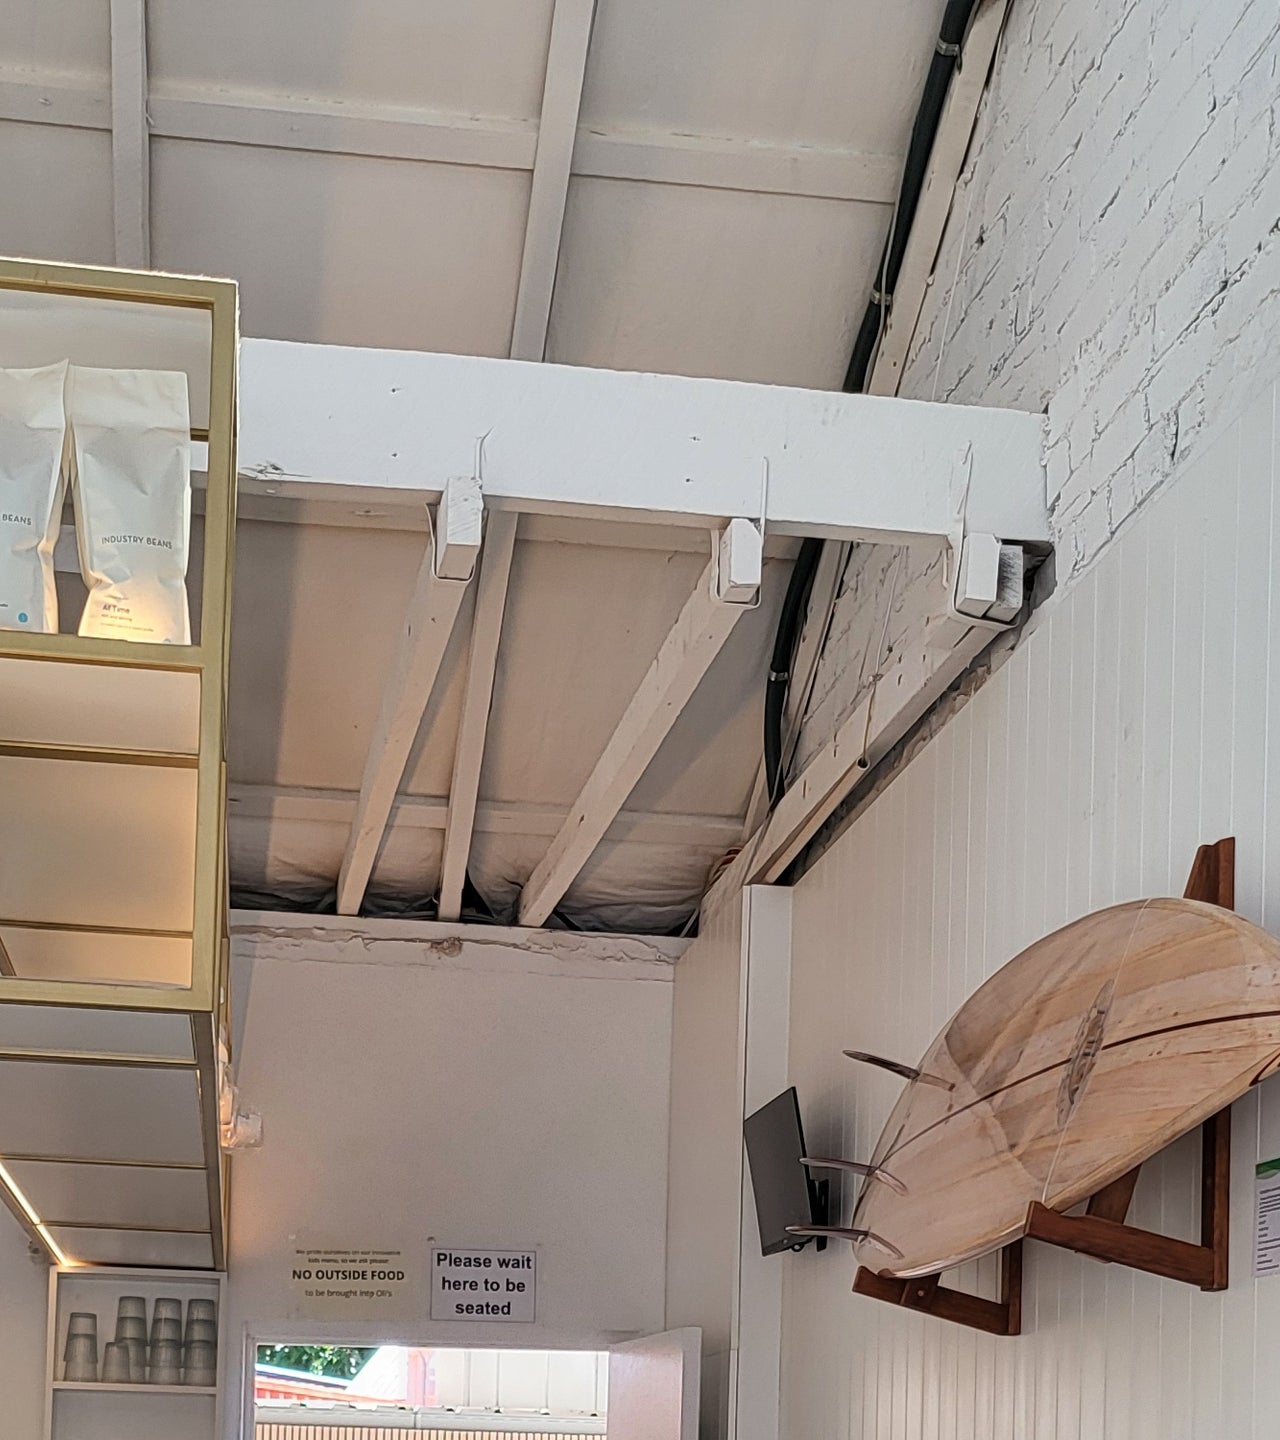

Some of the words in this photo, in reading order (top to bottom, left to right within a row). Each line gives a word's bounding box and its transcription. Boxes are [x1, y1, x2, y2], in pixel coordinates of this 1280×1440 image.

[2, 513, 32, 526] BEANS
[101, 535, 145, 545] INDUSTRY
[146, 536, 173, 550] BEANS
[436, 1252, 492, 1269] Please
[497, 1254, 532, 1270] wait
[292, 1270, 312, 1280] NO
[315, 1270, 368, 1280] OUTSIDE
[371, 1270, 405, 1280] FOOD
[441, 1276, 479, 1292] here
[483, 1278, 500, 1293] to
[505, 1278, 526, 1293] be
[327, 1289, 357, 1298] brought
[455, 1301, 511, 1316] seated
